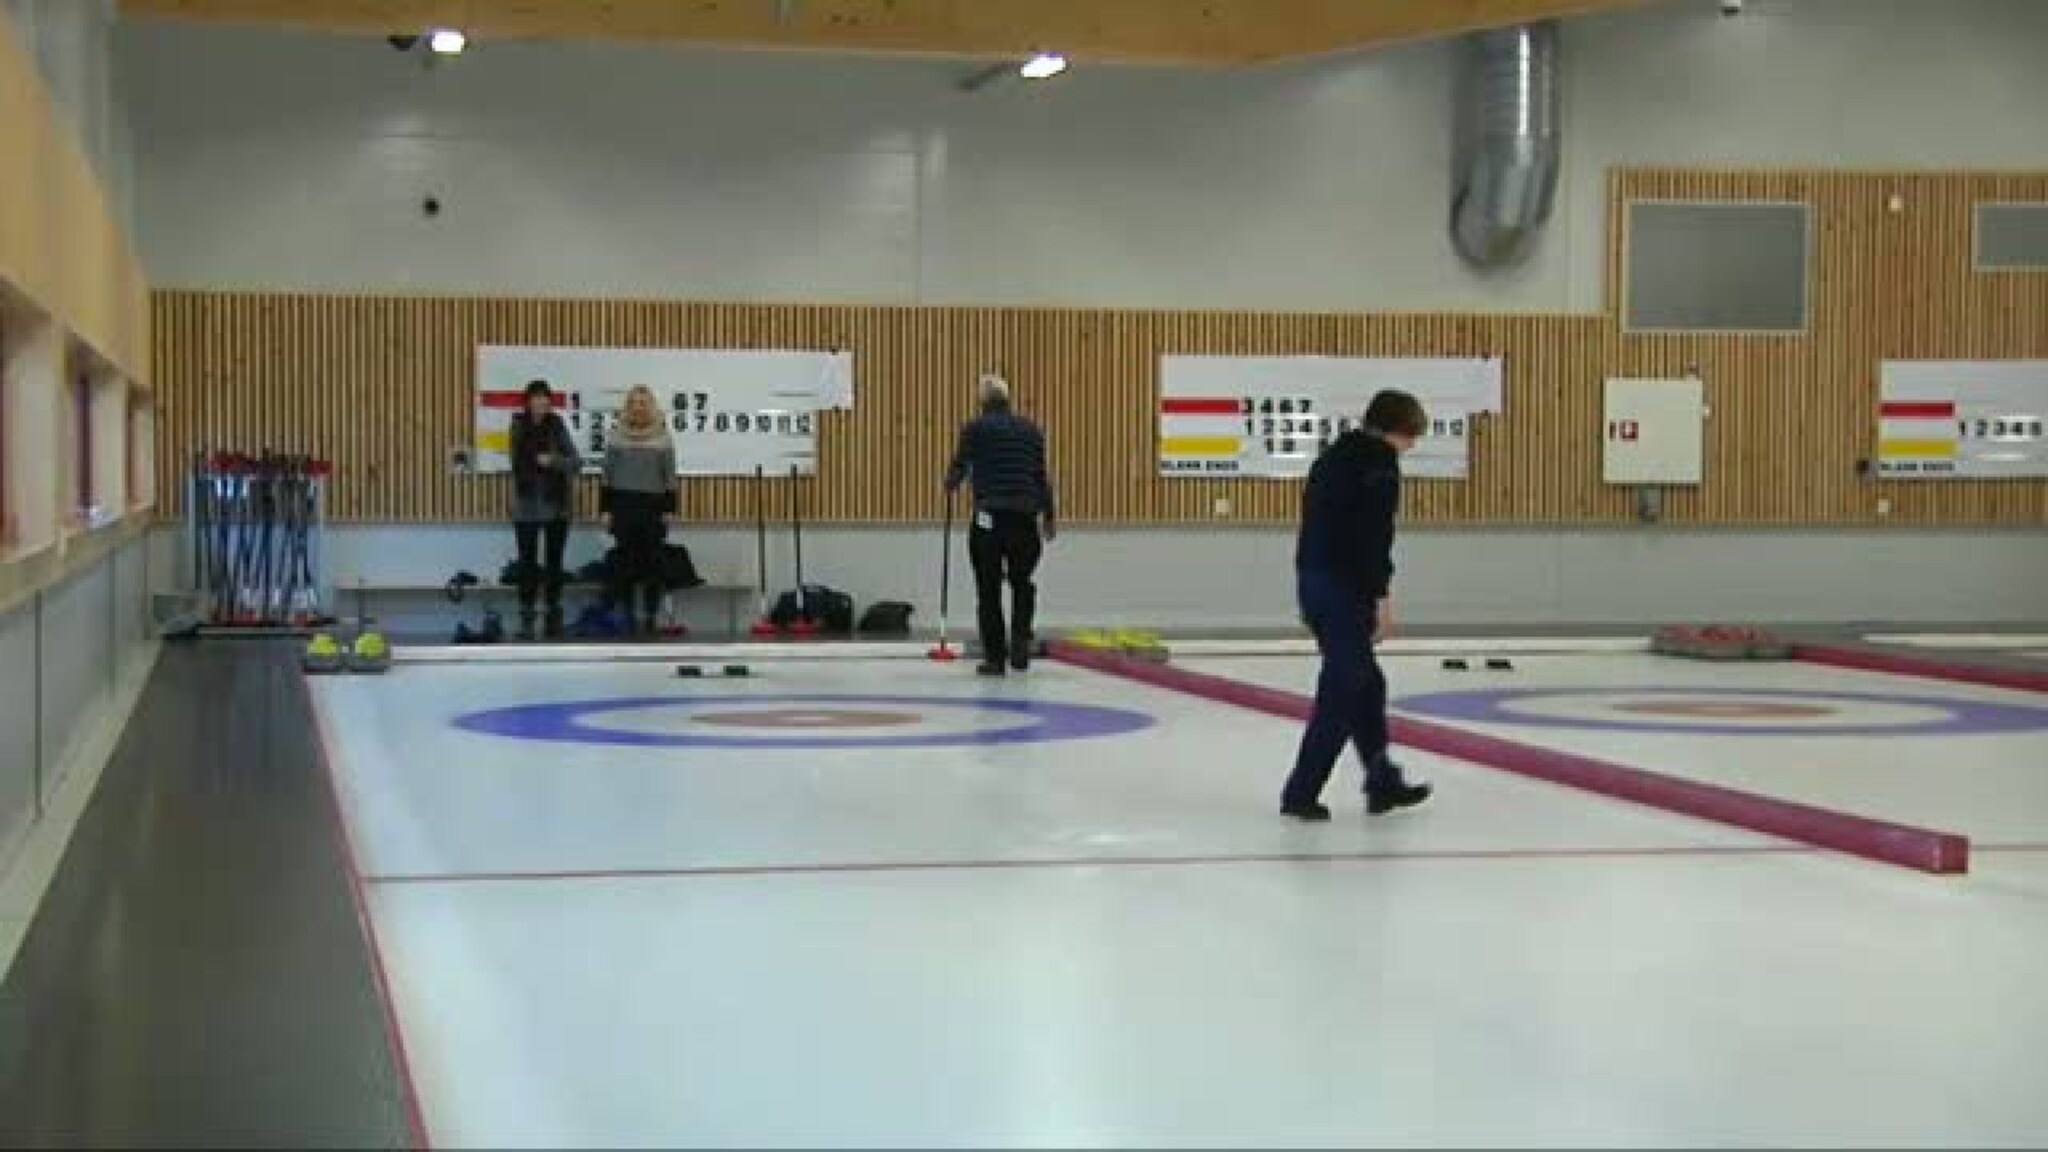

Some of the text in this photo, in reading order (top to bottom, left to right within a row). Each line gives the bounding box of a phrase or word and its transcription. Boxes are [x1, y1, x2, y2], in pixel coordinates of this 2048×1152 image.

[694, 393, 708, 410] 7
[1299, 399, 1312, 413] 7
[673, 413, 688, 432] 6
[695, 414, 708, 432] 7
[735, 413, 750, 432] 9
[1281, 419, 1294, 434] 3
[1299, 419, 1312, 432] 4
